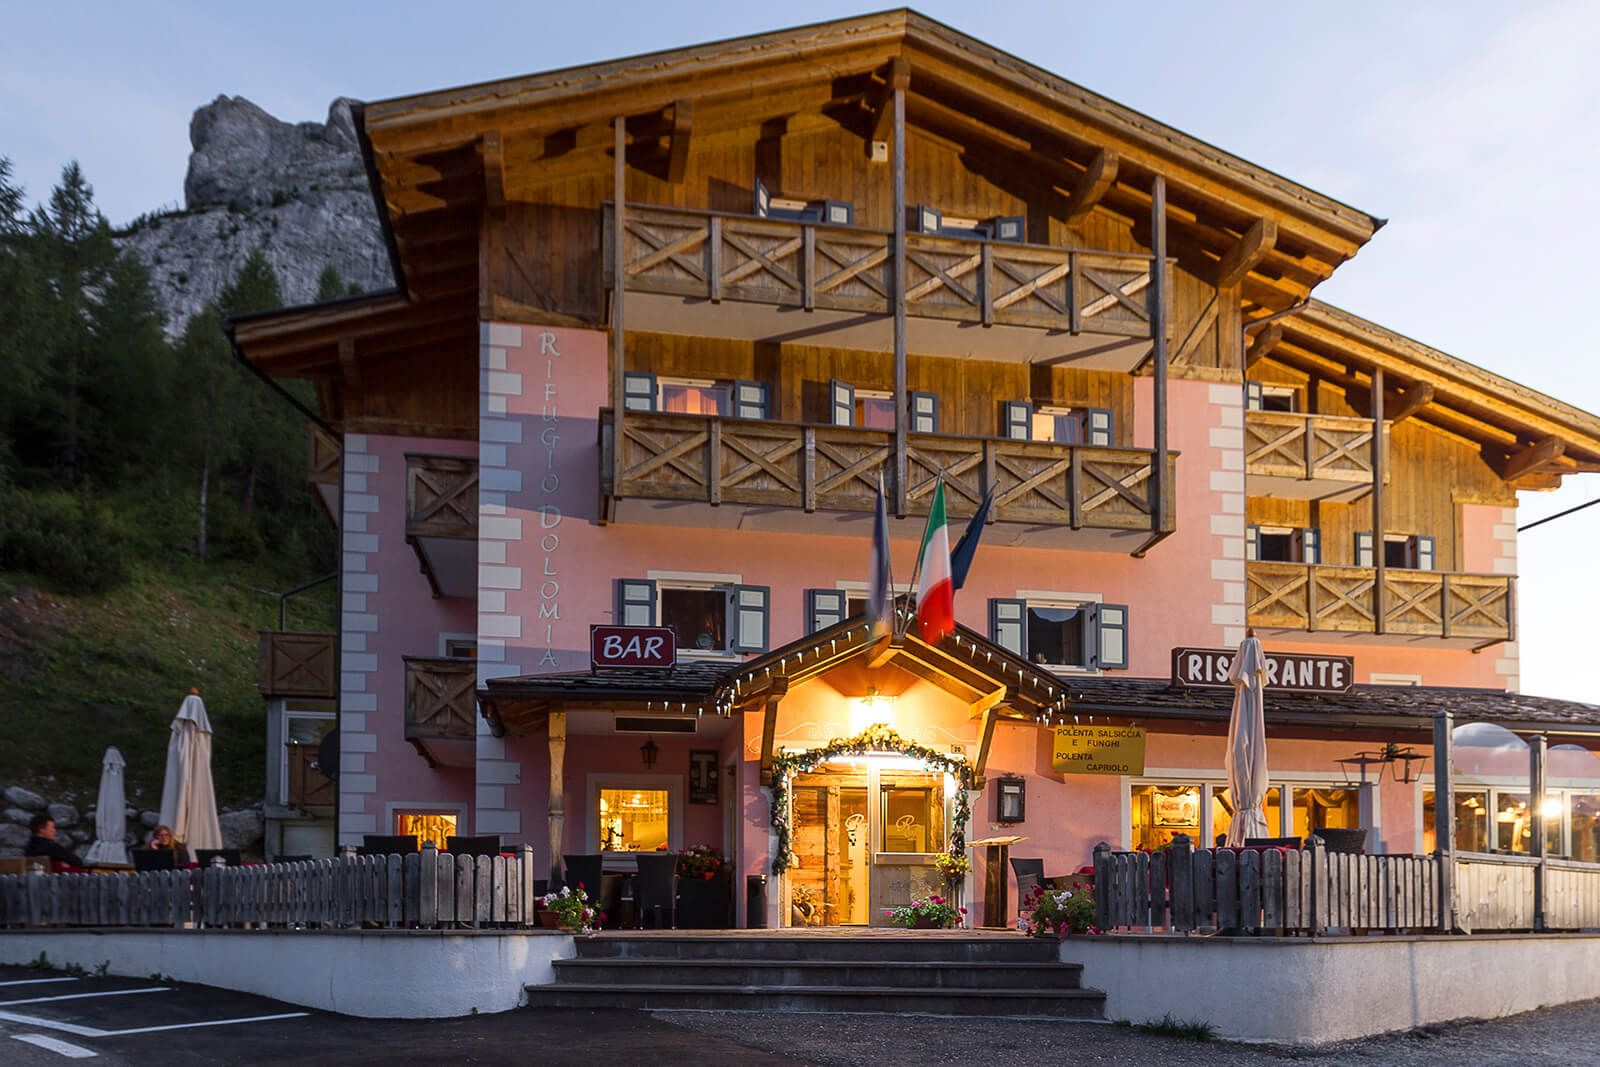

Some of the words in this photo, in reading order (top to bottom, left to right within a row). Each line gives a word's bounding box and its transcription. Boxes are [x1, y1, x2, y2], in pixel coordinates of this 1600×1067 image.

[538, 331, 561, 494] RIFUGIO
[538, 504, 562, 668] DOLOMIA
[603, 635, 664, 660] BAR
[1188, 654, 1344, 688] RISRANTE
[1057, 728, 1094, 737] POLENTA
[1097, 729, 1142, 738] SALSICCIA
[1087, 739, 1120, 748] FUNGHI
[1056, 752, 1094, 761] POLENTA
[1086, 763, 1129, 772] CAPRIOLO
